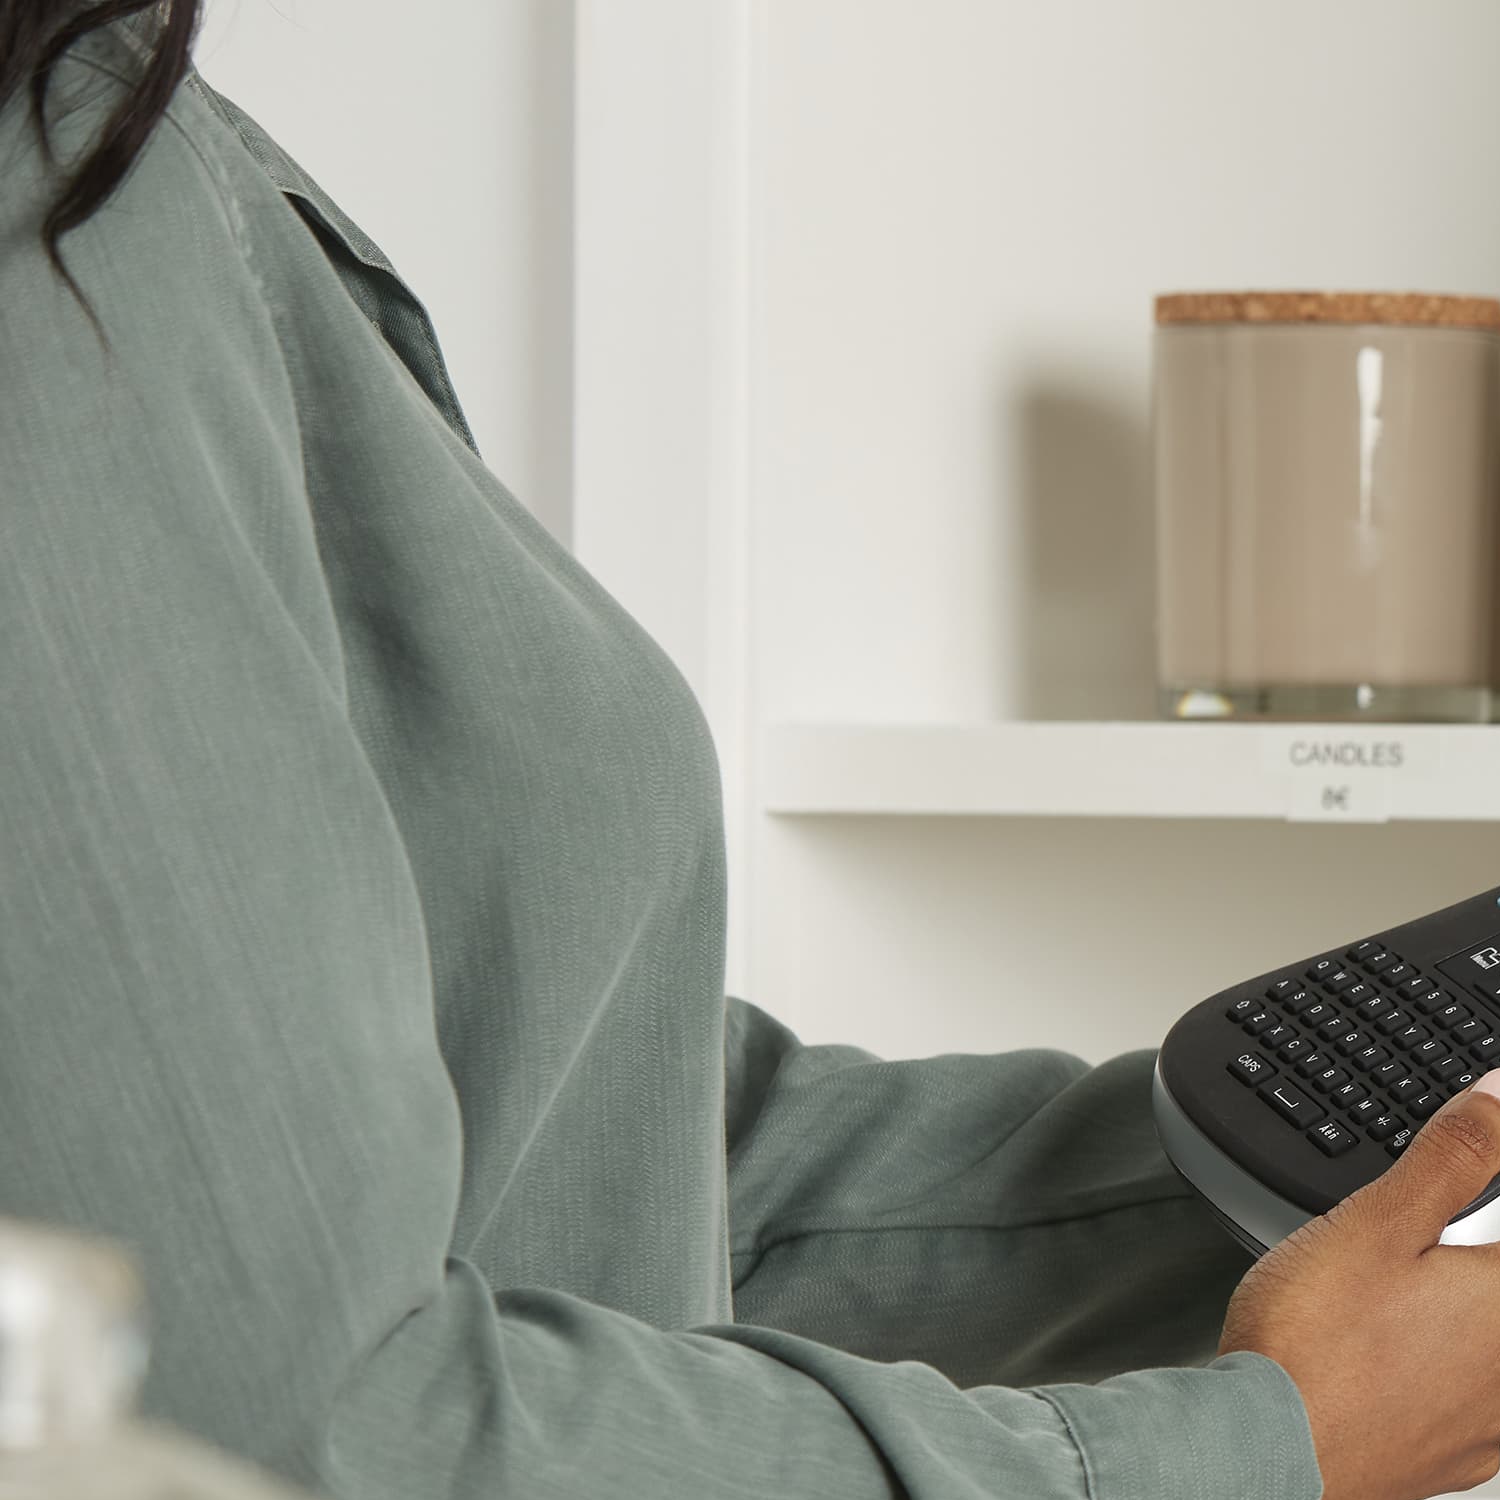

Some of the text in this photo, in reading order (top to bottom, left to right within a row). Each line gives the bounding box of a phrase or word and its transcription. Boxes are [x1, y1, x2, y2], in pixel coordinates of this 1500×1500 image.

[1289, 740, 1405, 767] CANDLES
[1276, 980, 1289, 988] A
[1293, 992, 1306, 1000] S
[1310, 1005, 1323, 1014] D
[1327, 1018, 1341, 1026] F
[1345, 1033, 1358, 1042] G
[1362, 1047, 1376, 1057] H
[1398, 1078, 1412, 1088] K
[1351, 984, 1364, 993] E
[1368, 997, 1381, 1007] R
[1387, 1011, 1399, 1020] T
[1404, 1027, 1417, 1035] Y
[1422, 1041, 1436, 1050] U
[1444, 1006, 1457, 1014] 6
[1481, 1037, 1494, 1046] 8
[1238, 1054, 1261, 1073] CAPS
[1270, 1025, 1284, 1035] X
[1287, 1040, 1300, 1049] C
[1306, 1054, 1319, 1063] V
[1322, 1069, 1335, 1078] B
[1340, 1084, 1354, 1094] N
[1358, 1100, 1373, 1110] M
